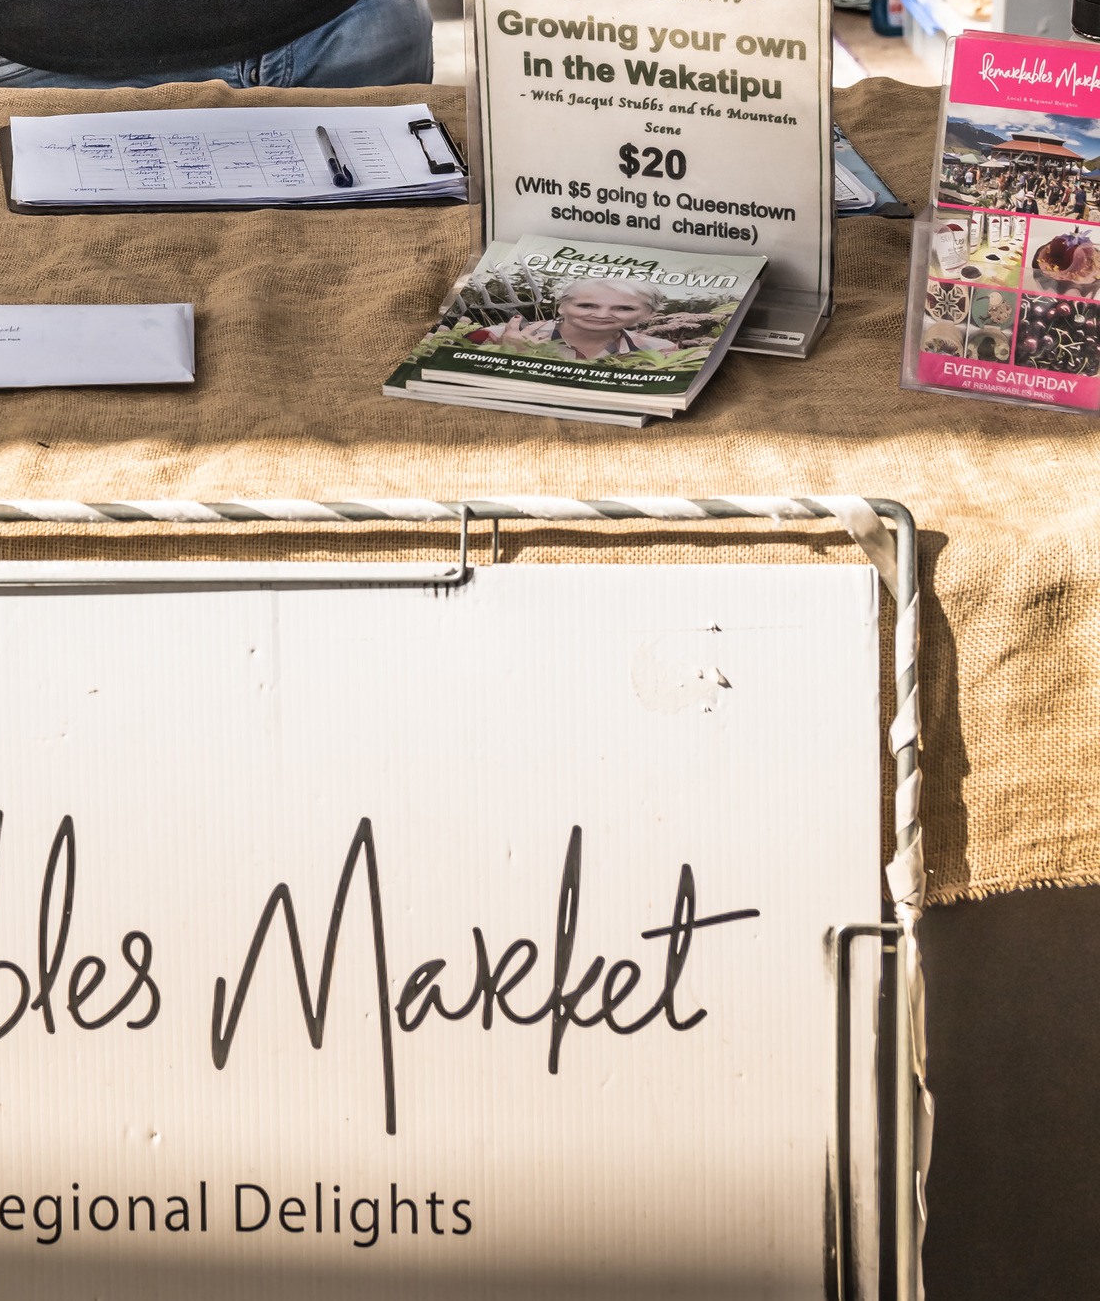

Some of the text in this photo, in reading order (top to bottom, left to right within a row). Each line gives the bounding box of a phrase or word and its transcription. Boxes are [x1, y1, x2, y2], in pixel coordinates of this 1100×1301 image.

[497, 9, 807, 61] Growing your own
[523, 51, 782, 102] in the Wakatipu
[979, 52, 1053, 92] Remarkables
[530, 89, 564, 103] With
[568, 92, 614, 110] Jacqui
[618, 97, 664, 112] Stubbs
[669, 102, 695, 115] and
[700, 104, 721, 118] the
[727, 108, 798, 126] Mountain
[1054, 100, 1078, 108] Delights
[644, 122, 681, 136] Scene
[618, 143, 687, 180] $20
[514, 175, 796, 222] (With $5 going to Queenstown
[551, 205, 759, 245] schools and charities)
[523, 253, 739, 288] Queenstown
[553, 246, 659, 273] Raising
[452, 351, 676, 383] GROWING YOUR OWN IN THE WAKATIPU
[943, 361, 1078, 394] EVERY SATURDAY
[973, 382, 1032, 397] REMARKABLES
[1033, 391, 1055, 400] PARK
[212, 816, 760, 1135] Market
[235, 1181, 475, 1249] Delights
